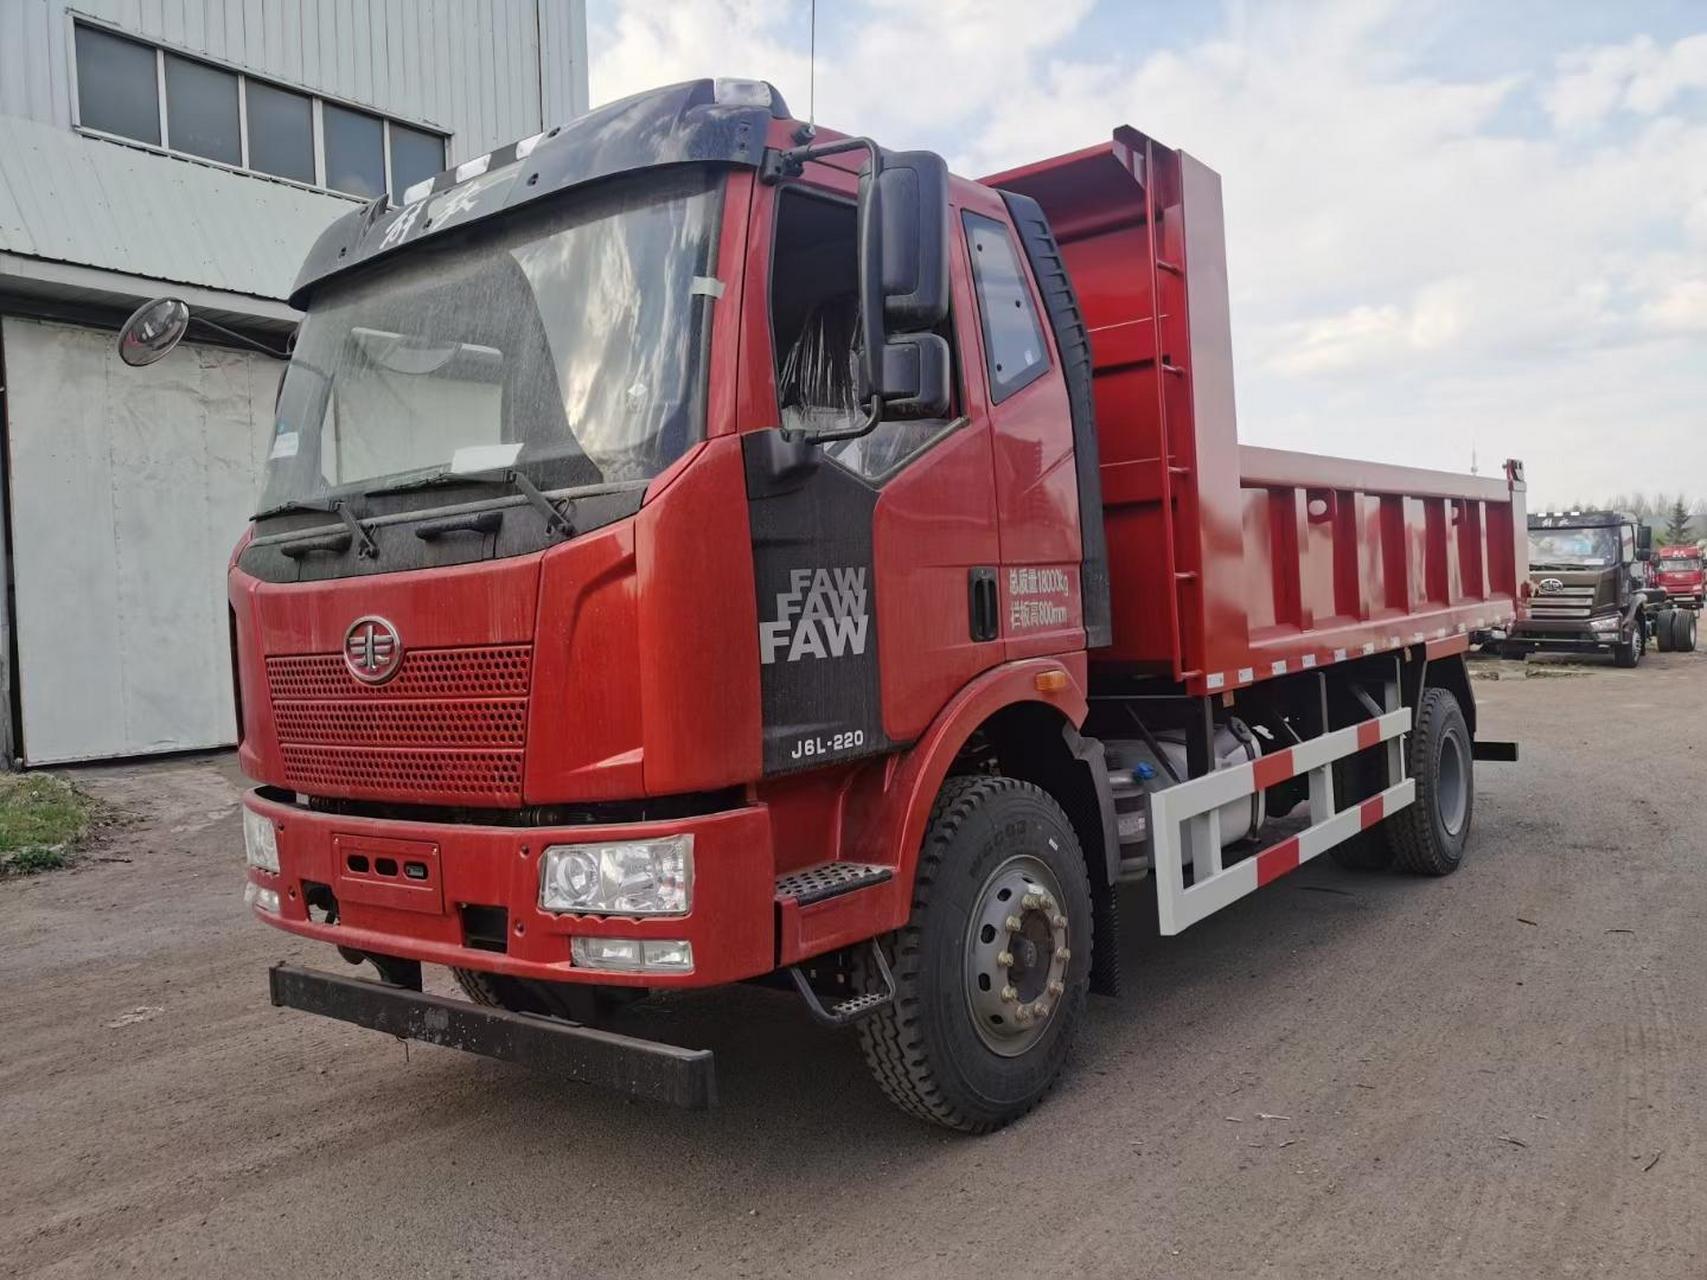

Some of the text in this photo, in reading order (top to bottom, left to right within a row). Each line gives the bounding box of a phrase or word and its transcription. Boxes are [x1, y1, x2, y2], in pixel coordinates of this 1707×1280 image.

[790, 567, 866, 595] FAW
[776, 589, 867, 624] FAW
[759, 615, 869, 664] FAW
[791, 730, 864, 759] J6L-220
